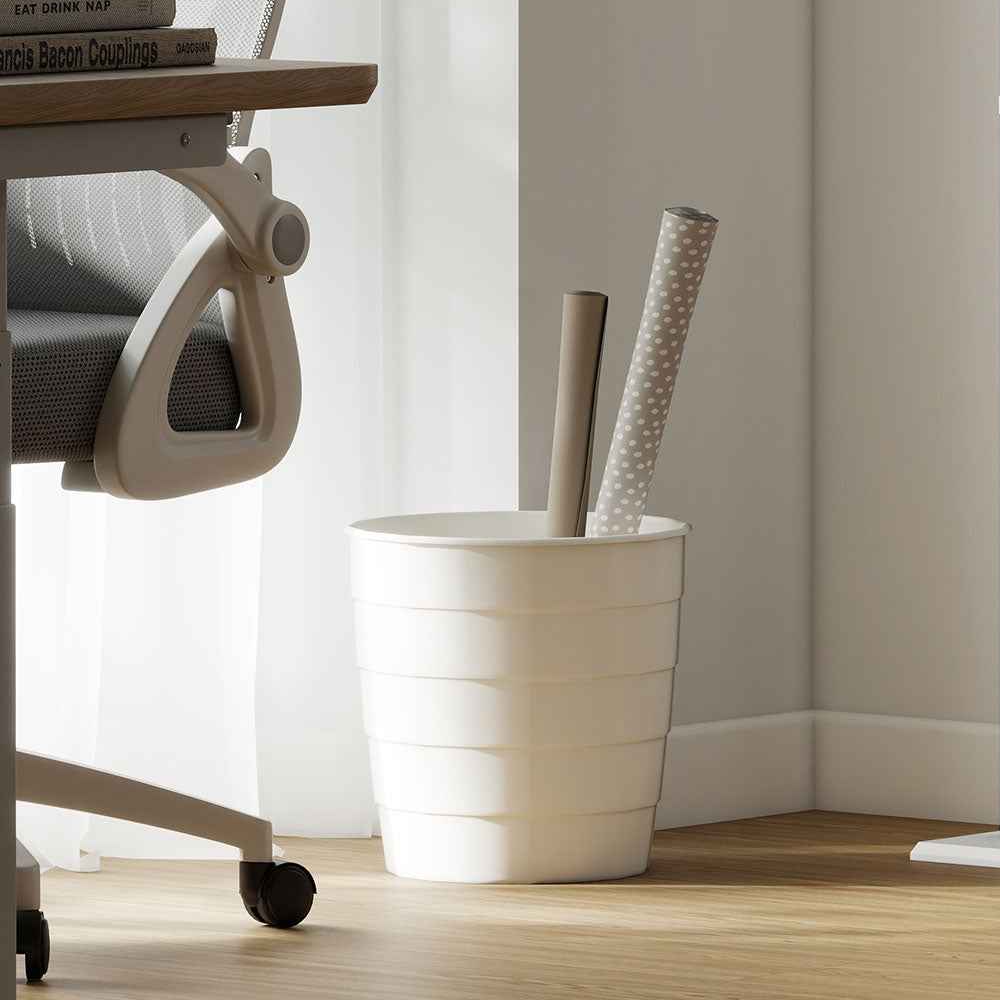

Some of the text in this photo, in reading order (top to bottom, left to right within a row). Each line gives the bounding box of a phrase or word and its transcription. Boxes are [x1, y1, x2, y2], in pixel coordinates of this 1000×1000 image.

[15, 0, 111, 15] EAT DRINK NAP
[38, 40, 83, 69] Bacon
[88, 36, 158, 68] Couplings
